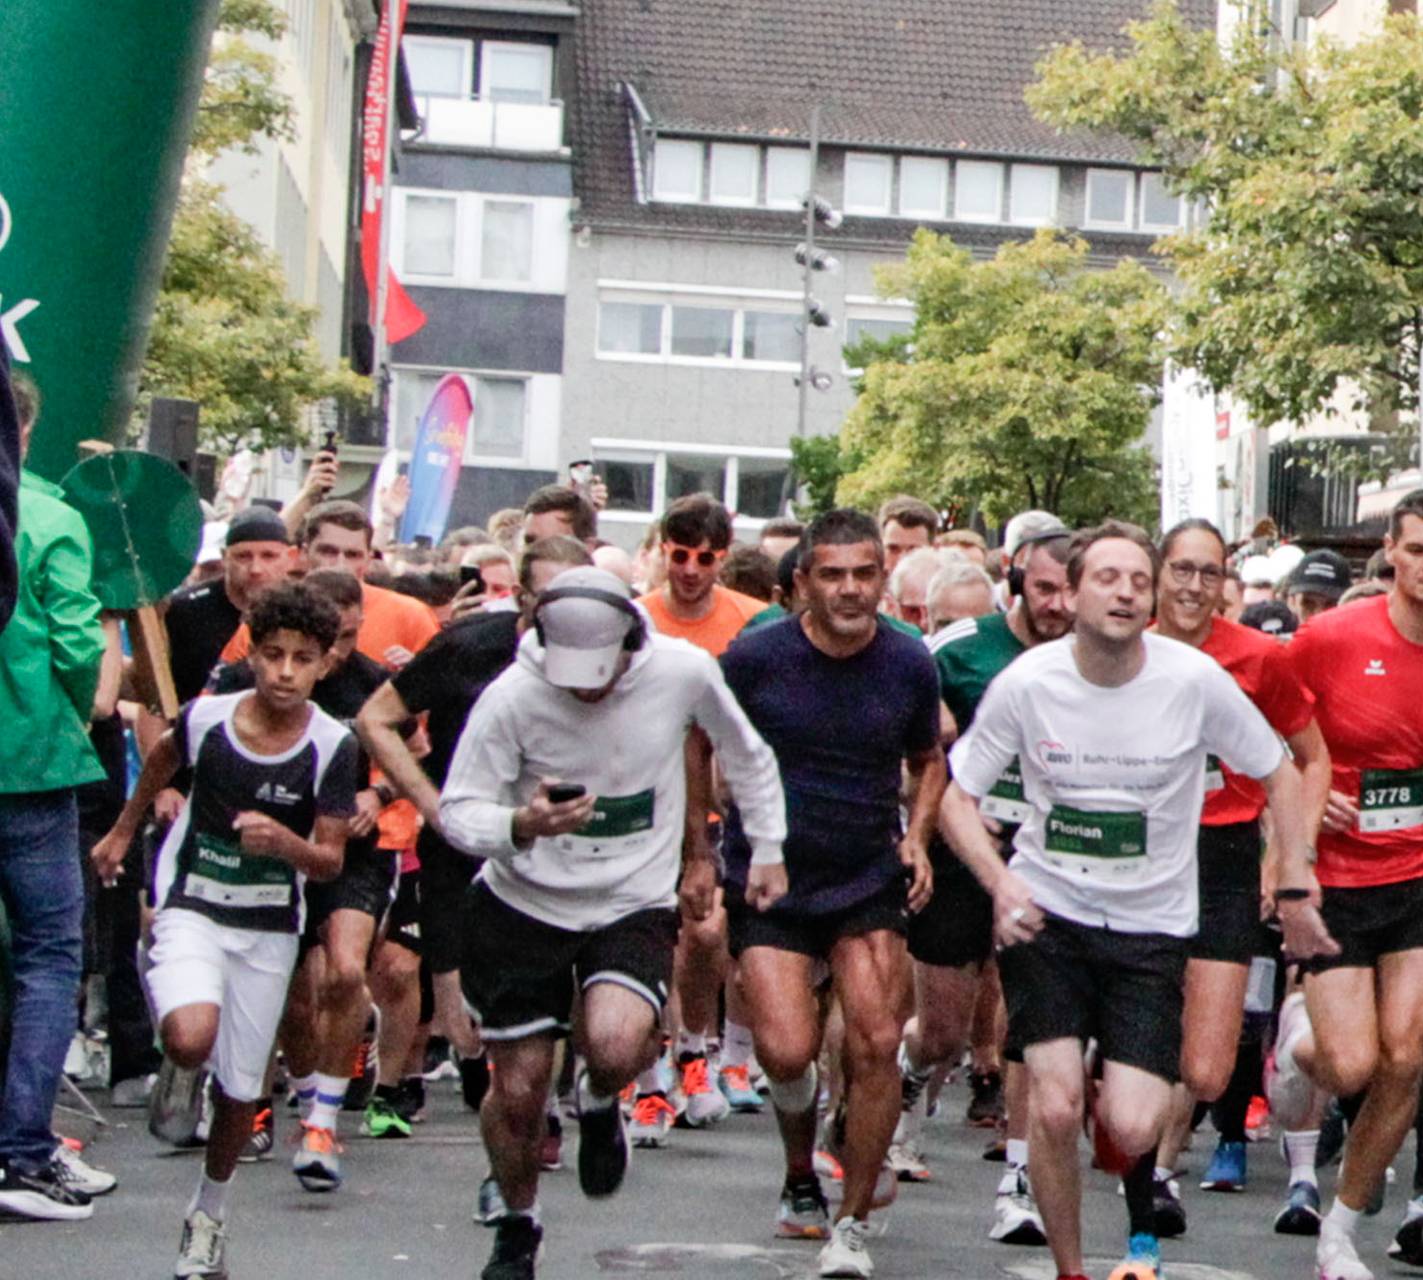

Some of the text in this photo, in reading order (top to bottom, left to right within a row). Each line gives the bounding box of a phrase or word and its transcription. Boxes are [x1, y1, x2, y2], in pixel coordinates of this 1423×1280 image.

[1365, 788, 1411, 805] 3778
[1051, 820, 1103, 838] Florian
[199, 847, 241, 868] Khalil
